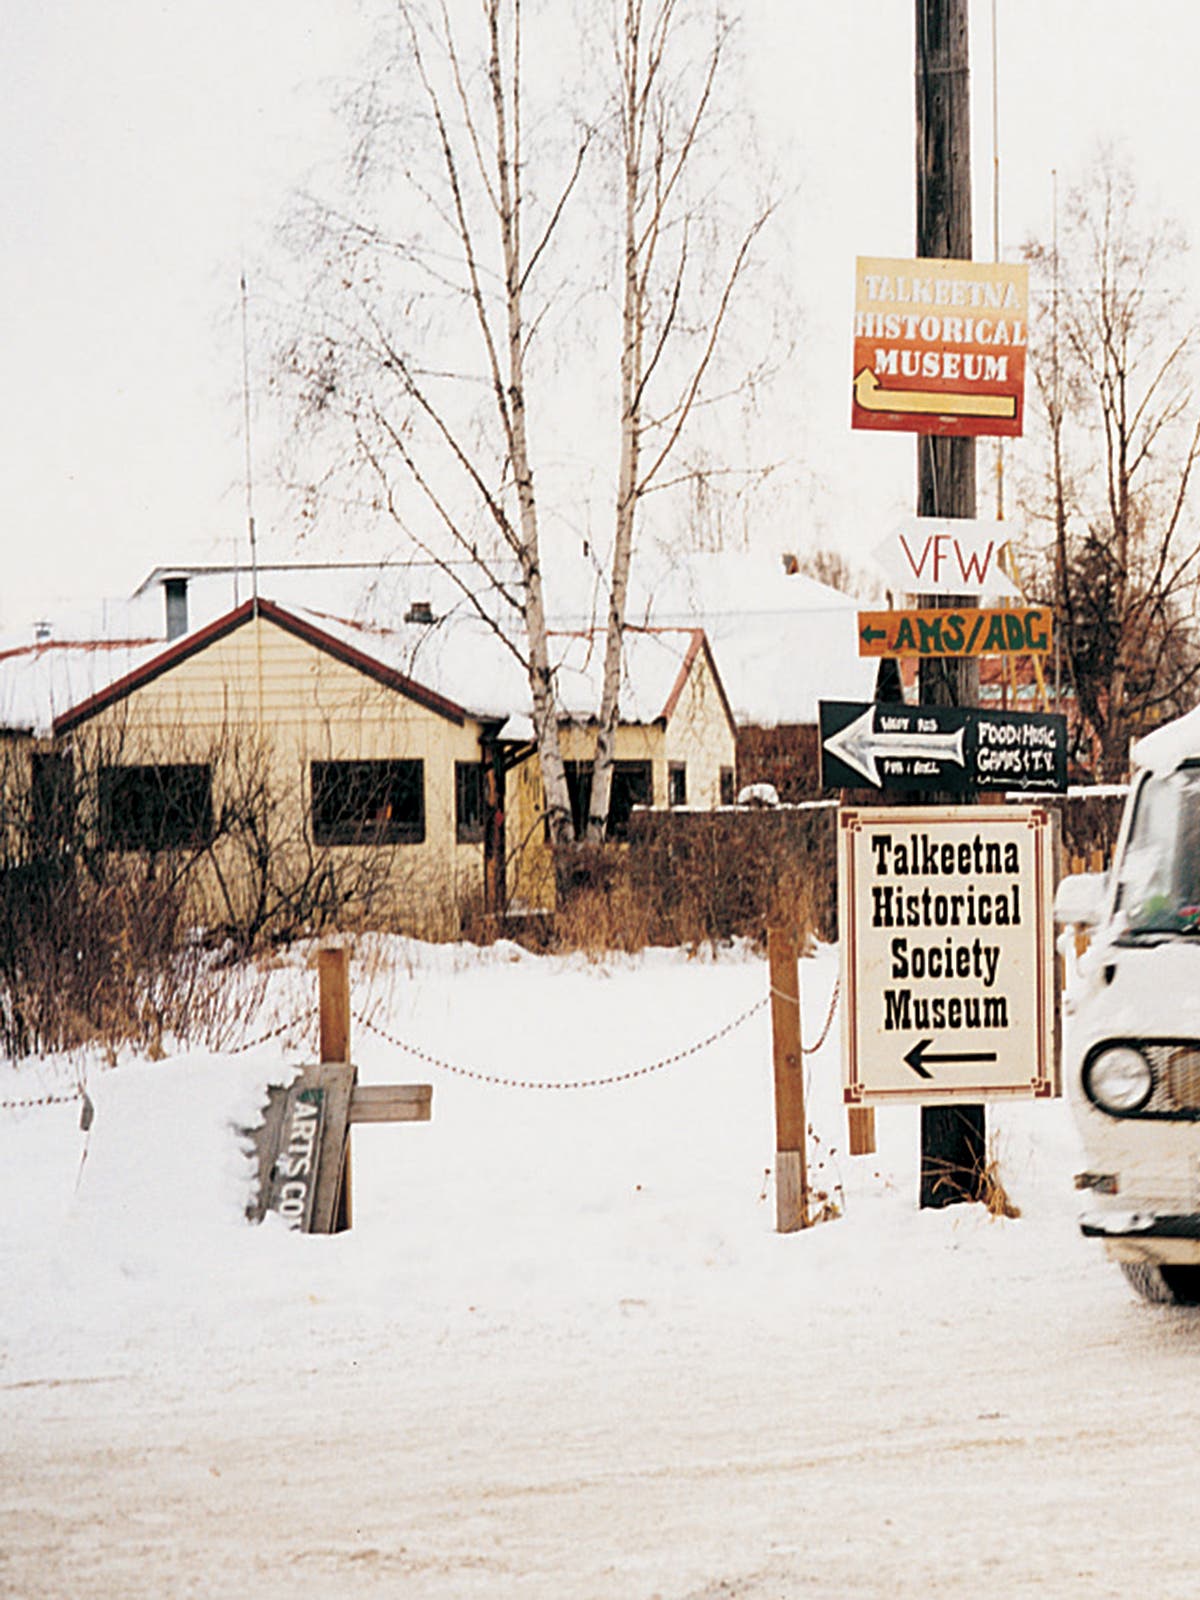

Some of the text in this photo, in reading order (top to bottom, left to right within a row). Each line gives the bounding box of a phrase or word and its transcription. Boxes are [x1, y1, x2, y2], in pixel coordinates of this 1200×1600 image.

[864, 275, 1021, 309] TALKEETNA
[854, 312, 1029, 347] HISTORICAL
[874, 348, 1009, 382] MUSEUM
[899, 534, 995, 584] VFW
[978, 722, 1017, 746] FOOD
[872, 834, 1019, 875] Talkeetna
[872, 885, 1020, 927] Historical
[891, 937, 1000, 987] Society
[884, 989, 1008, 1030] Museum
[287, 1101, 319, 1178] ARTS
